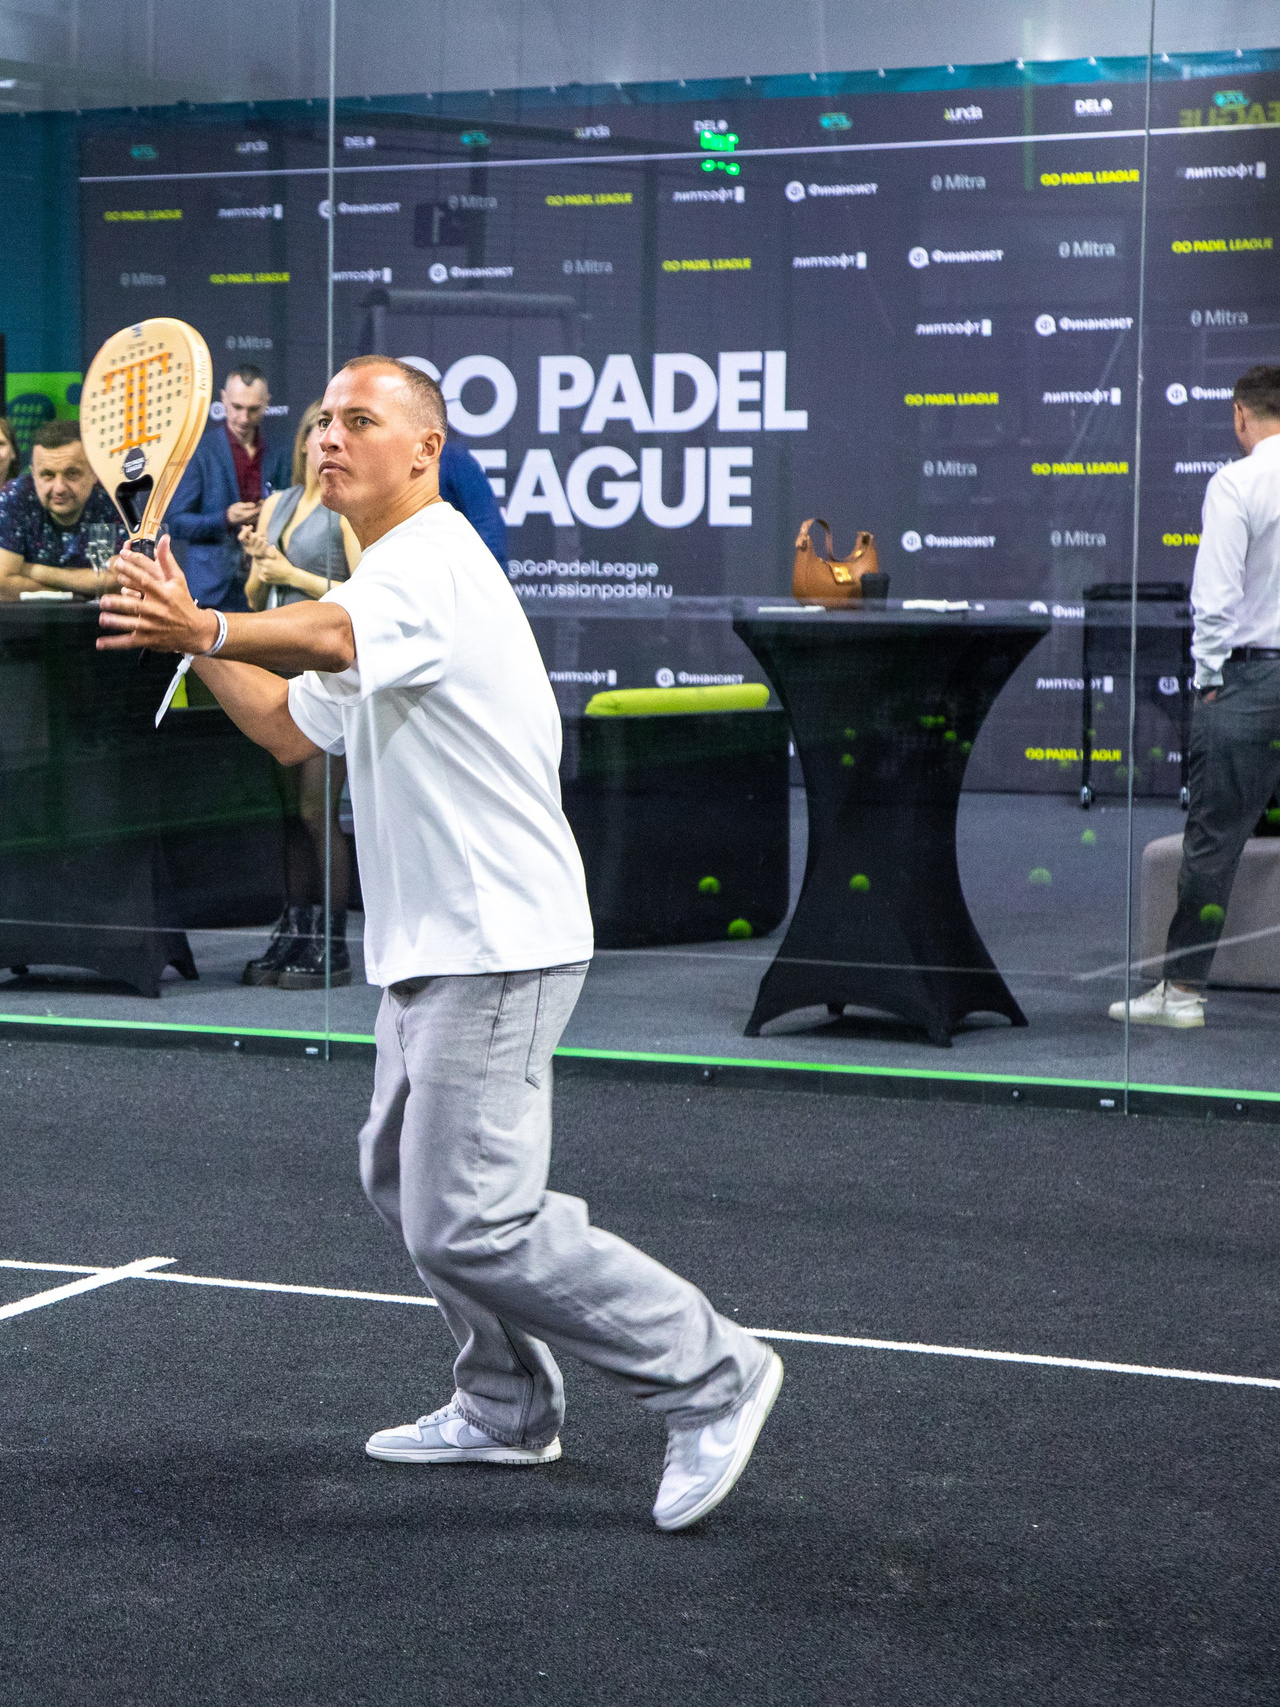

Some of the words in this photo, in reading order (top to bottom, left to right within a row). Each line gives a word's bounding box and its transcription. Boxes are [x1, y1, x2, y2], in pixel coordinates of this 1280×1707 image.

[1040, 173, 1060, 186] GO
[1061, 171, 1095, 185] PADEL
[1096, 168, 1140, 183] LEAGUE
[546, 194, 563, 206] GO
[564, 194, 593, 205] PADEL
[594, 192, 632, 204] LEAGUE
[1172, 240, 1192, 254] GO
[1193, 239, 1228, 253] PADEL
[1229, 237, 1273, 251] LEAGUE
[662, 260, 681, 272] GO
[681, 259, 712, 271] PADEL
[712, 257, 751, 270] LEAGUE
[539, 350, 808, 434] PADEL
[904, 393, 924, 406] GO
[924, 393, 957, 406] PADEL
[958, 391, 999, 405] LEAGUE
[1191, 386, 1234, 400] Финан
[1031, 462, 1051, 476] GO
[1052, 462, 1085, 475] PADEL
[1086, 460, 1129, 475] LEAGUE
[1175, 460, 1232, 473] липтсо
[468, 446, 753, 529] AGUE
[1162, 533, 1182, 546] GO
[508, 559, 659, 580] @GoPadelLeague
[513, 581, 673, 600] ww.russianpadel.ru
[1037, 677, 1101, 691] липтсот
[1025, 747, 1044, 760] GO
[1045, 747, 1079, 761] PADEL
[1080, 748, 1122, 761] LAGUE
